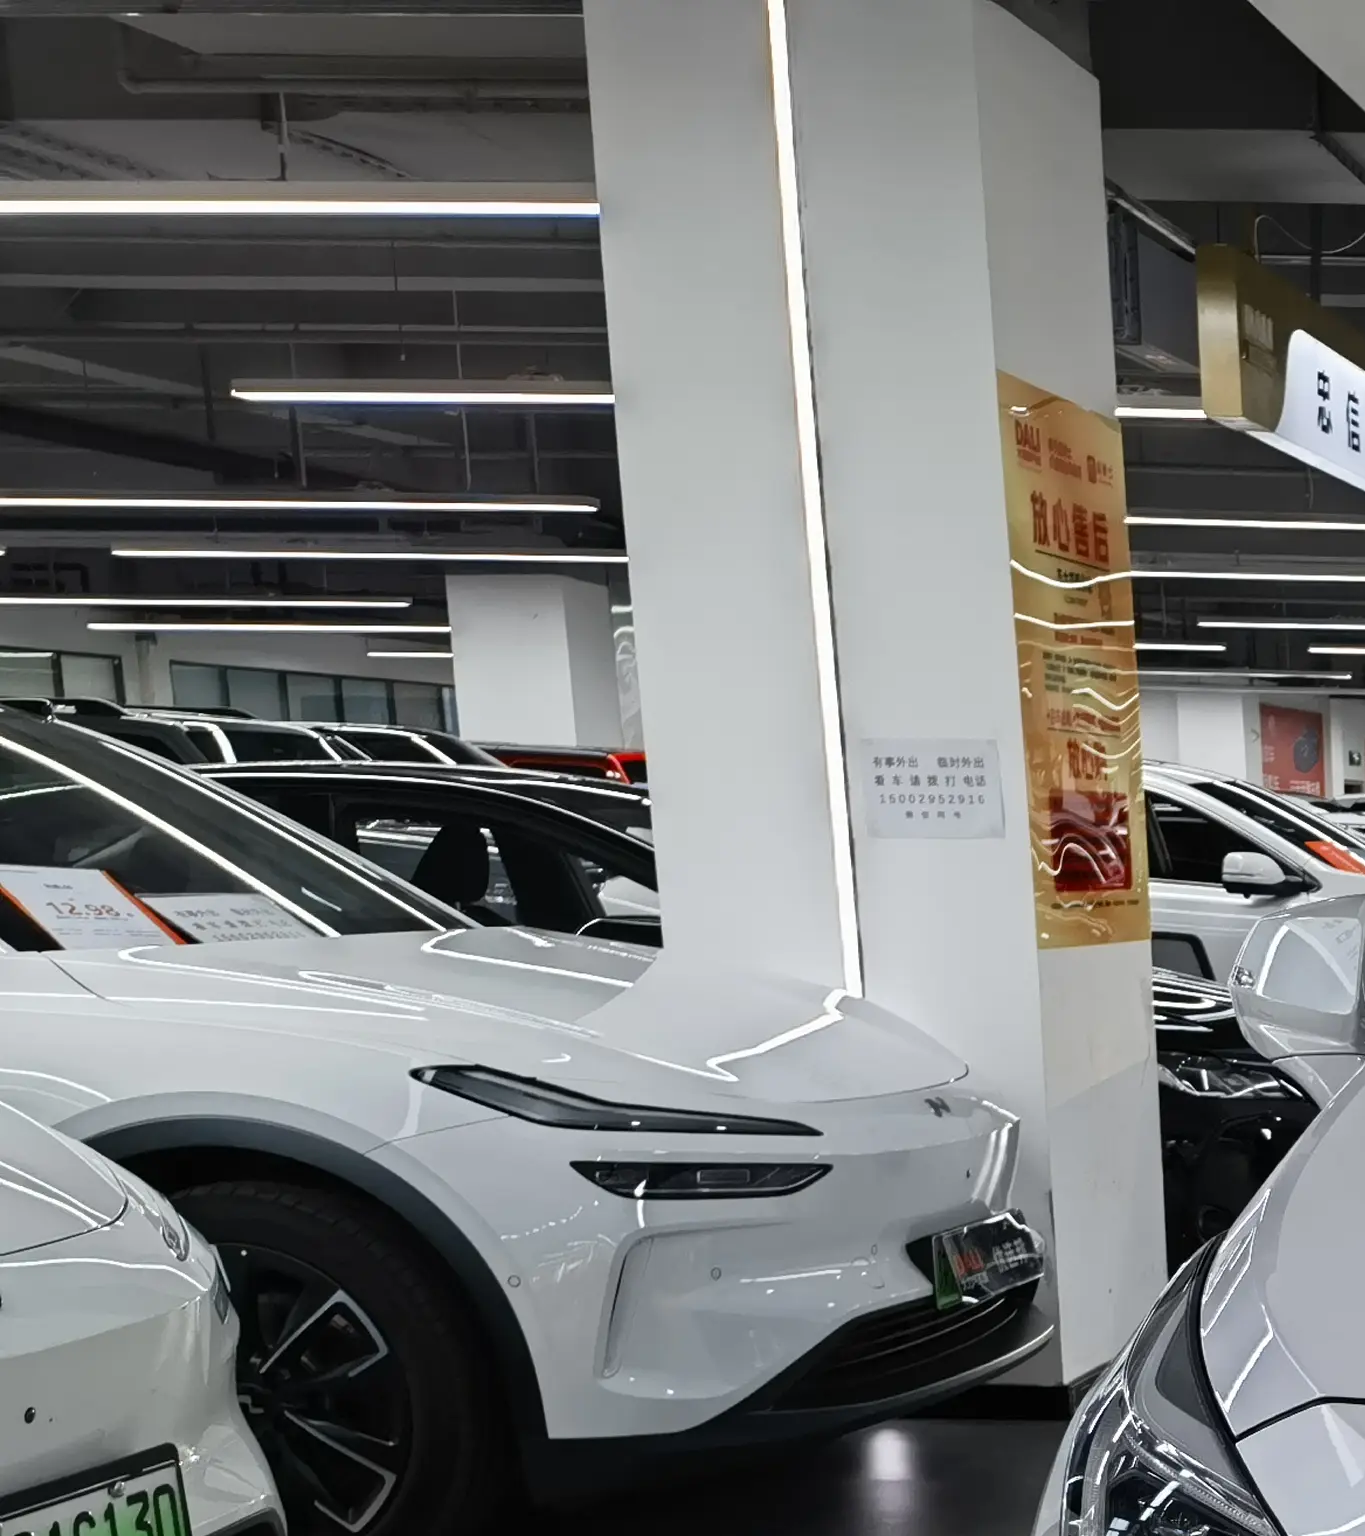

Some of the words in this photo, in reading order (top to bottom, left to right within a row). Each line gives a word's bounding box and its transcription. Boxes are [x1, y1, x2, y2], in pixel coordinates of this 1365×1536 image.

[1015, 419, 1041, 453] DALI
[1030, 490, 1109, 564] 放心售后
